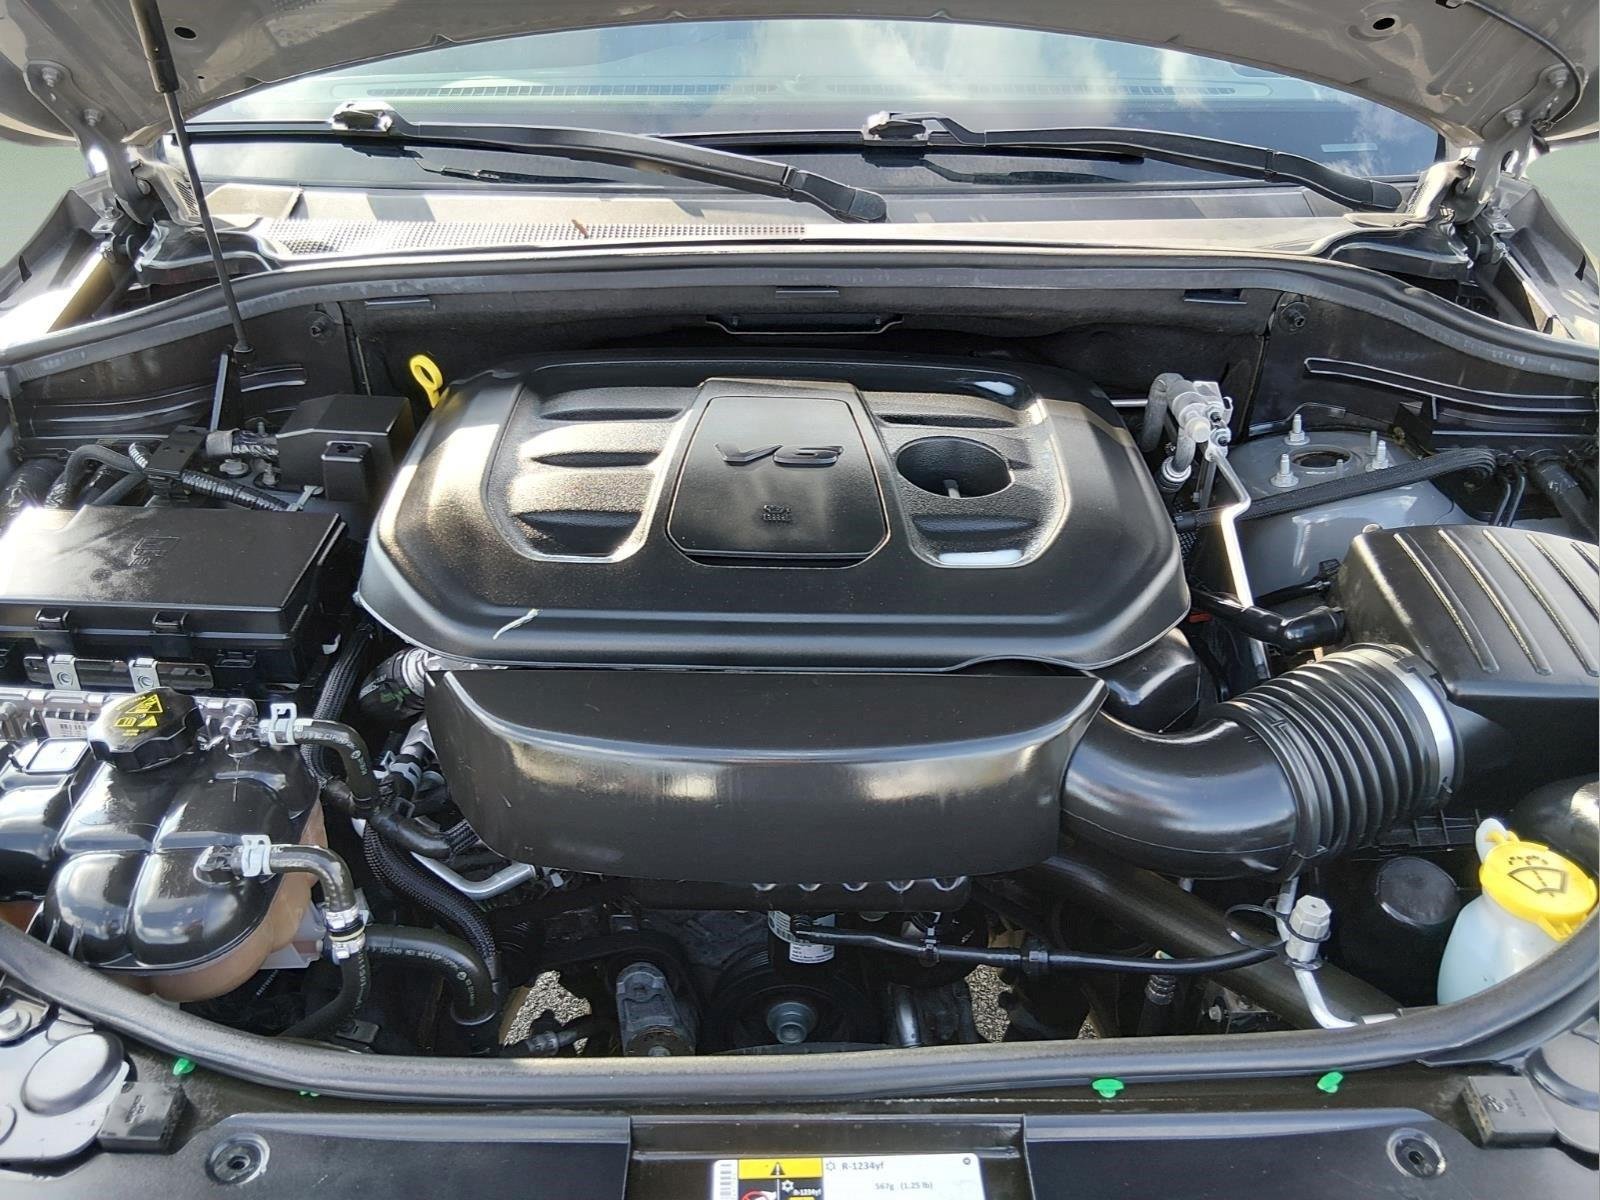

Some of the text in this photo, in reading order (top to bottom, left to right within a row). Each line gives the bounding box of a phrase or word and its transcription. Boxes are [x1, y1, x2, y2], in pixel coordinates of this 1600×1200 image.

[714, 443, 845, 469] V6
[841, 1160, 884, 1171] R-1234yf
[874, 1182, 895, 1191] 567g
[900, 1181, 921, 1191] (1.25
